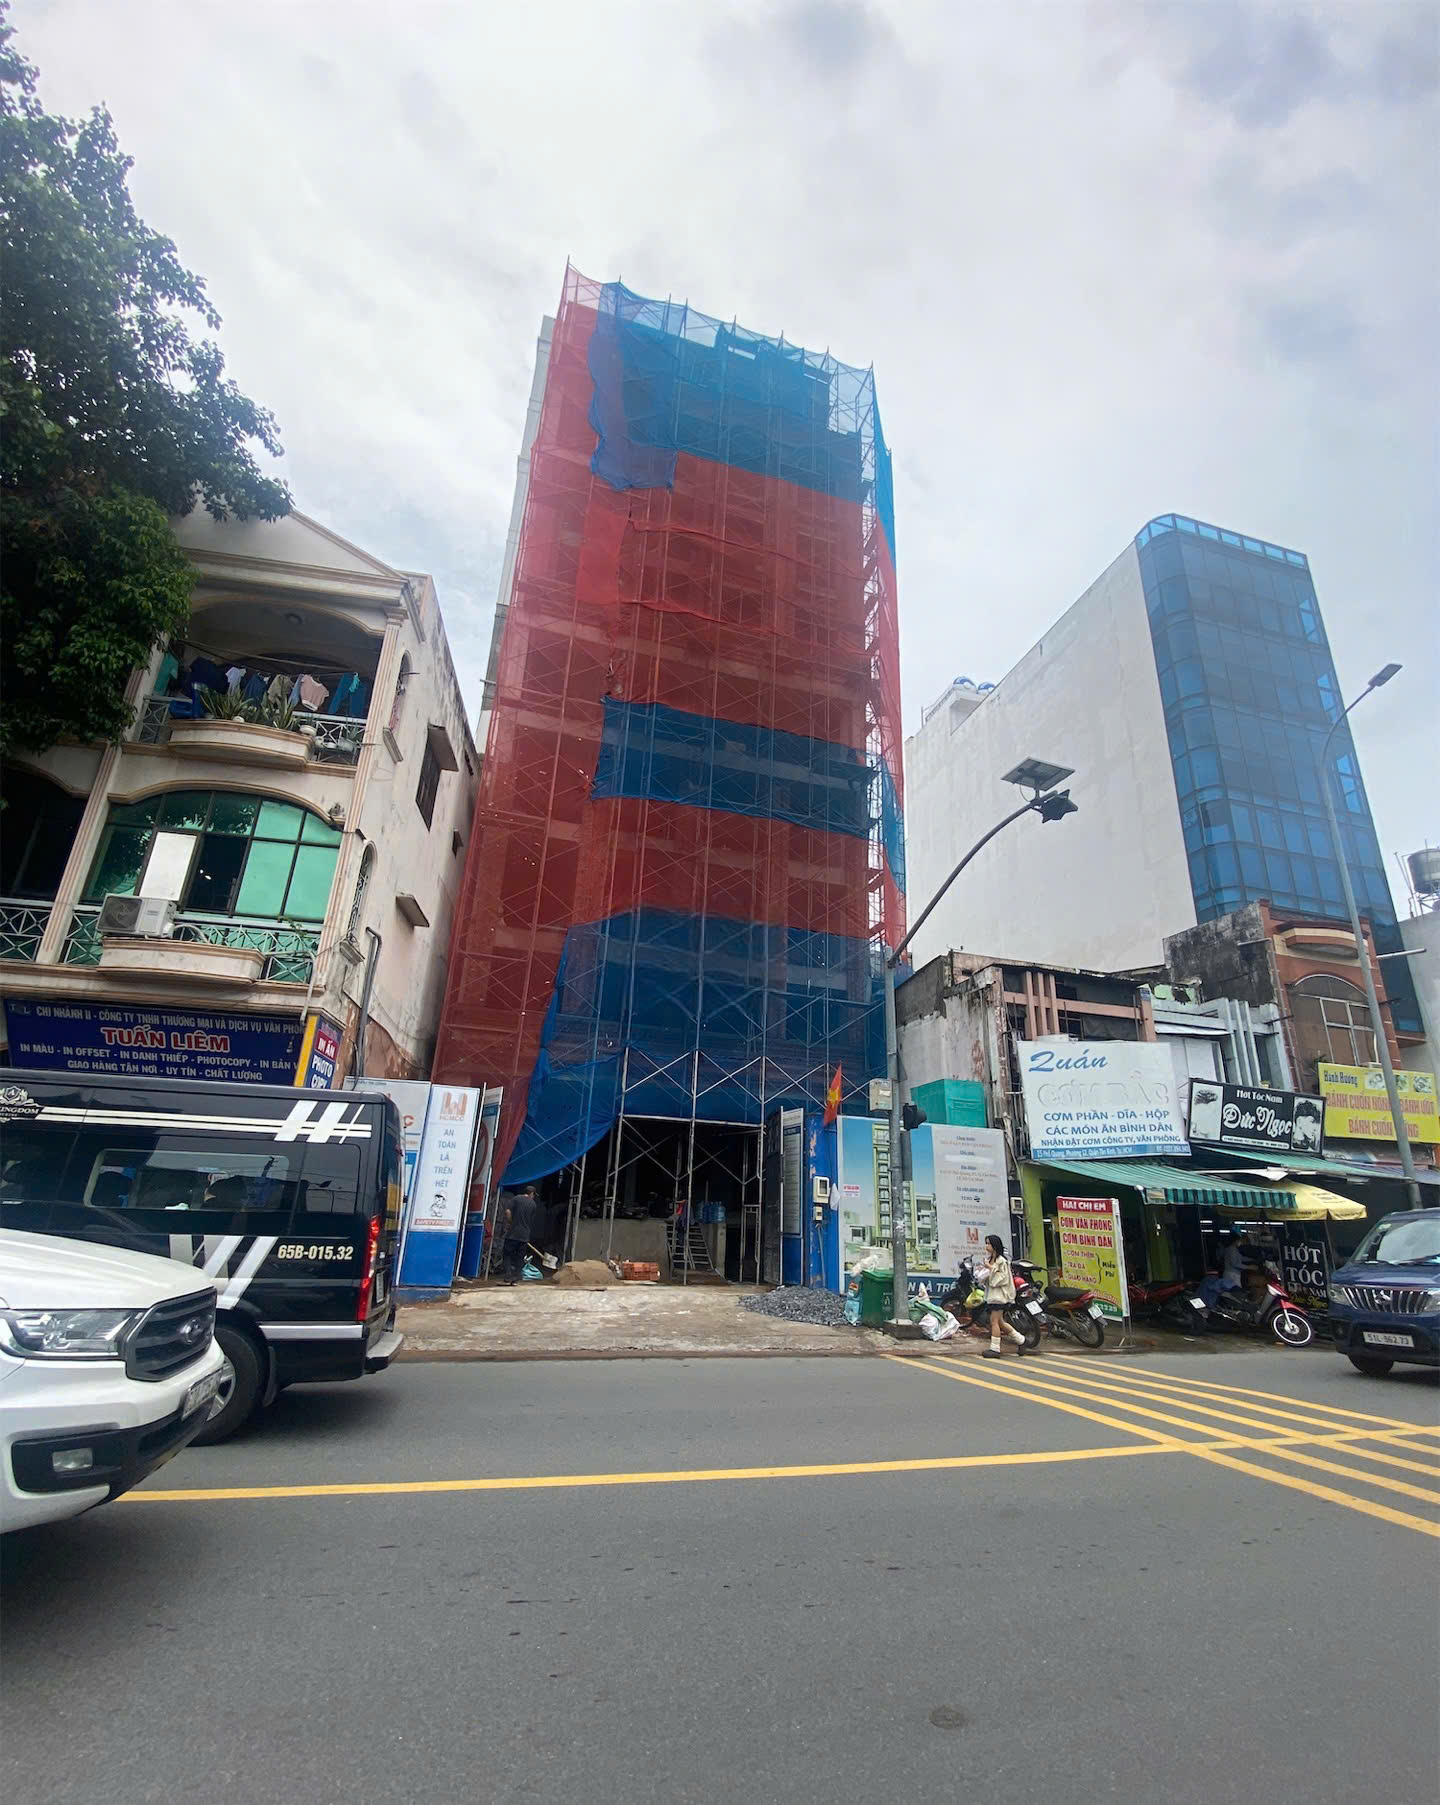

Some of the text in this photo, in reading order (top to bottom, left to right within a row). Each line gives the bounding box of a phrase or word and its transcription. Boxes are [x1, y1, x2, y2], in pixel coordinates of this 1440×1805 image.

[36, 1006, 51, 1016] CHI
[54, 1007, 83, 1019] NHÁNH
[99, 1009, 122, 1022] CÔNG
[124, 1012, 134, 1023] TY
[137, 1014, 160, 1025] TNHH
[162, 1014, 196, 1027] THƯƠNG
[197, 1017, 214, 1030] MẠI
[215, 1017, 227, 1030] VÀ
[229, 1019, 248, 1033] DỊCH
[250, 1021, 261, 1034] VỤ
[101, 1024, 231, 1053] TUẤN LIÊM
[318, 1038, 336, 1058] IN ẤN
[20, 1043, 30, 1052] IN
[33, 1043, 54, 1053] MÀU
[63, 1046, 73, 1055] IN
[76, 1048, 110, 1058] OFFSET
[120, 1050, 130, 1059] IN
[133, 1051, 158, 1061] DANH
[160, 1052, 188, 1063] THIẾP
[197, 1056, 250, 1067] PHOTOCOPY
[260, 1060, 269, 1069] IN
[272, 1058, 291, 1070] BẢN
[312, 1055, 333, 1077] PHOTO
[1029, 1049, 1108, 1072] Quán
[68, 1060, 262, 1081] GIAO HÀNG TẬN NƠI UY TÍN CHẤT LƯỢNG
[1265, 1094, 1283, 1103] Nam
[1044, 1108, 1170, 1121] CƠM PHẦN DĨA HỘP
[1223, 1103, 1256, 1129] Đức
[1046, 1122, 1173, 1136] CÁC MÓN ĂN BÌNH DÂN
[1349, 1116, 1370, 1134] BÁNH
[438, 1140, 456, 1149] TOÀN
[1041, 1138, 1064, 1147] NHẬN
[1066, 1138, 1080, 1147] ĐẶT
[1083, 1136, 1100, 1145] CƠM
[1102, 1135, 1123, 1144] CÔNG
[1137, 1134, 1152, 1143] VĂN
[1153, 1133, 1181, 1143] PHÒNG
[440, 1153, 449, 1161] LÀ
[434, 1166, 453, 1174] TRÊN
[1062, 1201, 1076, 1209] HAI
[1094, 1202, 1106, 1210] EM
[278, 1244, 354, 1260] 65B-015.32
[1284, 1243, 1320, 1264] HỚT
[1286, 1264, 1325, 1286] TÓC
